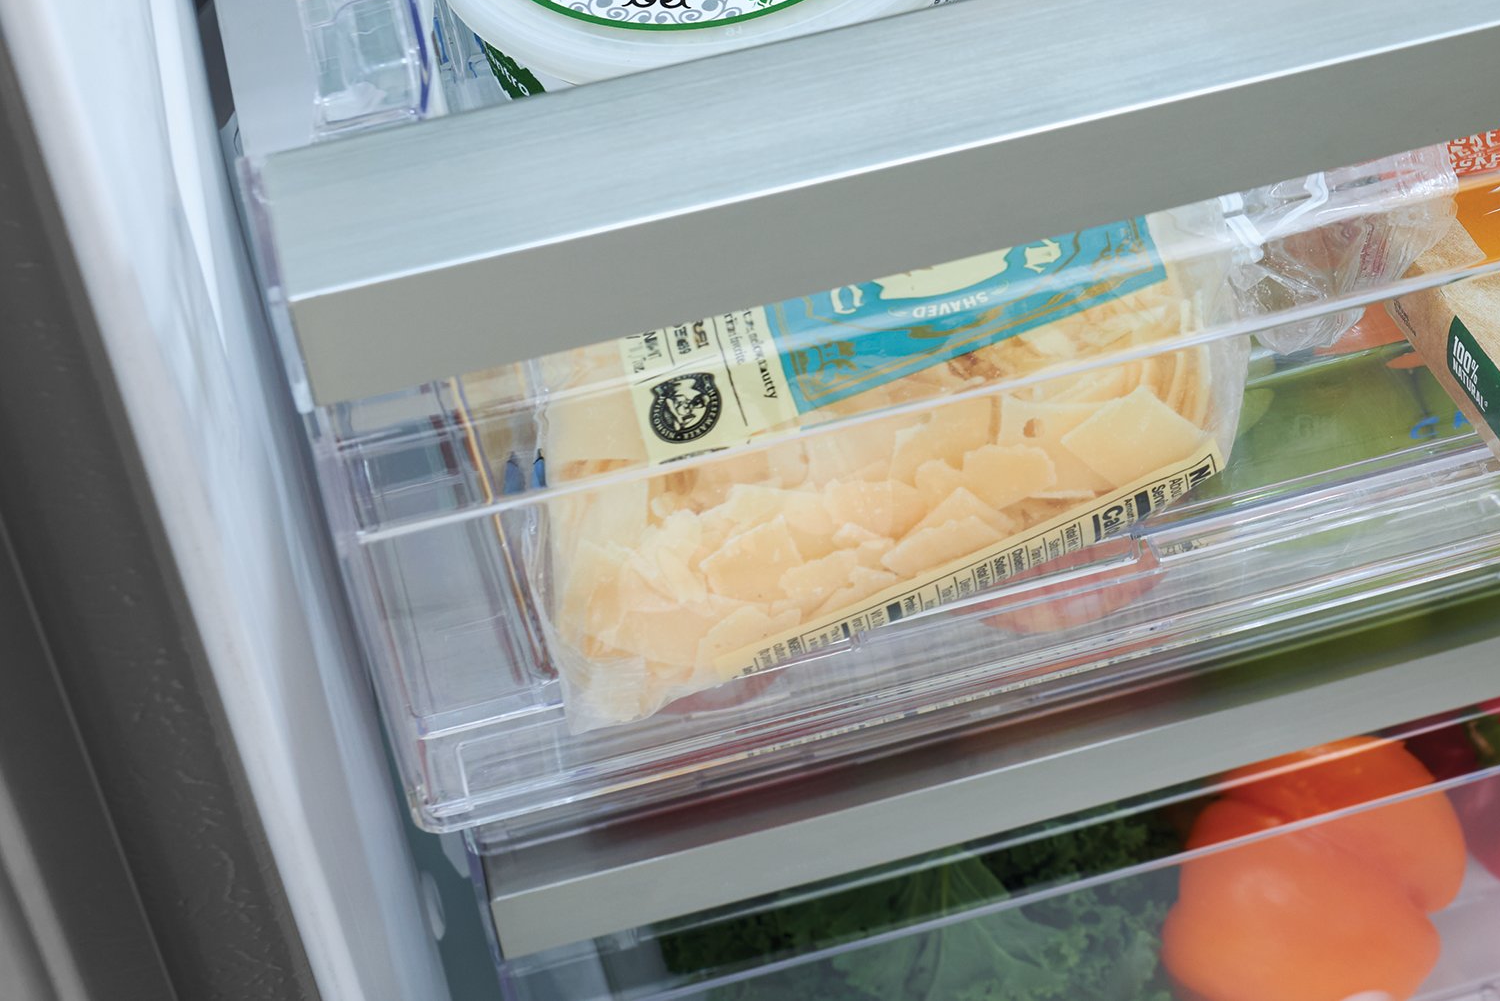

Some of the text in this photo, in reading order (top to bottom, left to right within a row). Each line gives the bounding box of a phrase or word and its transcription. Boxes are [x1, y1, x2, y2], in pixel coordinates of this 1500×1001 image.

[912, 291, 990, 320] SHAVED
[1452, 335, 1479, 385] 100%
[1452, 356, 1486, 413] NATURAL
